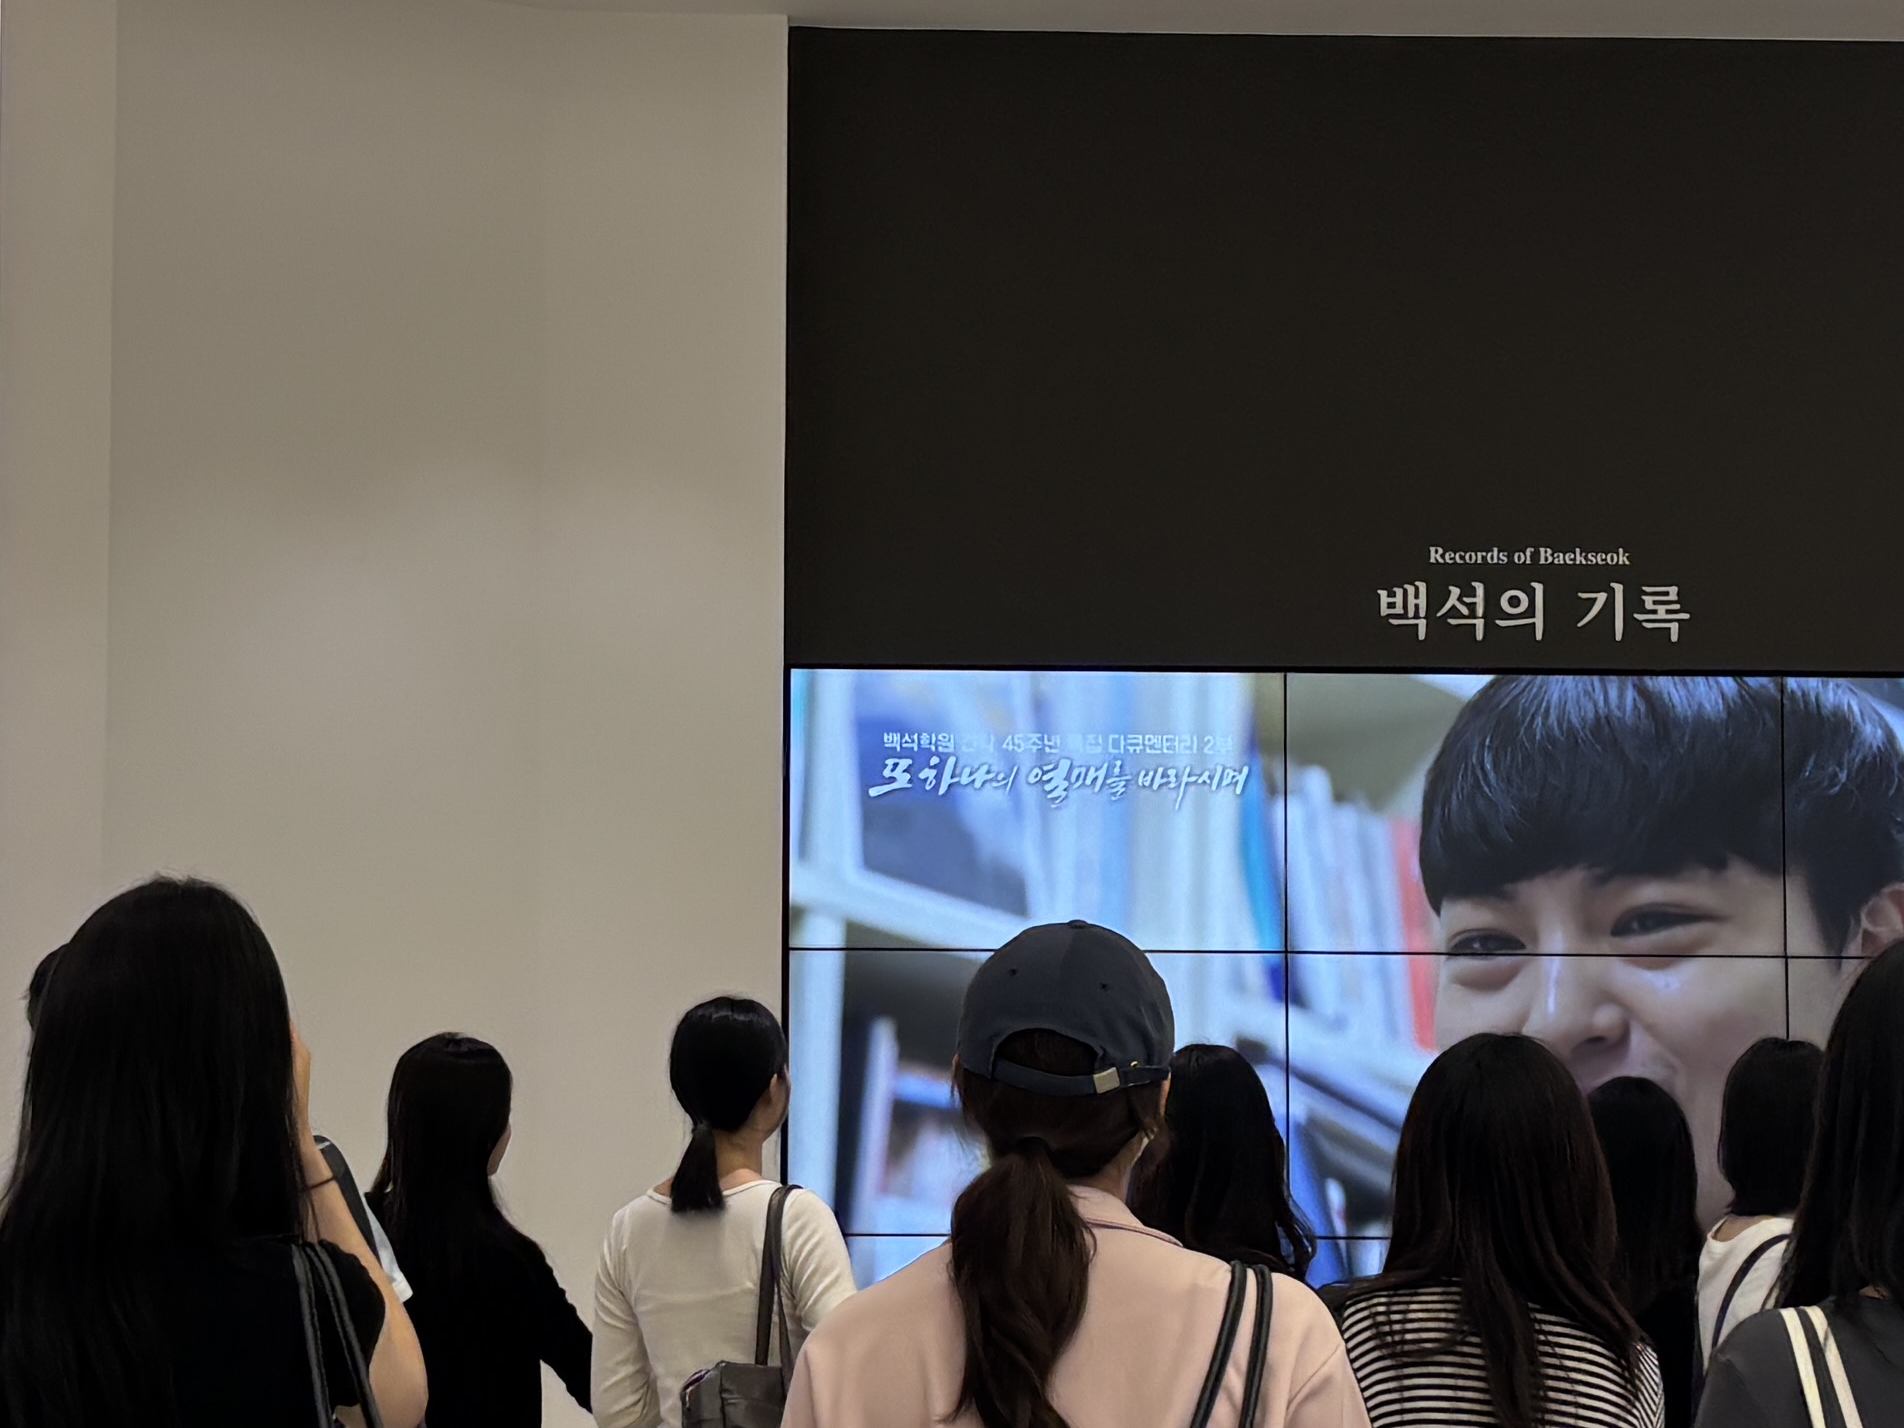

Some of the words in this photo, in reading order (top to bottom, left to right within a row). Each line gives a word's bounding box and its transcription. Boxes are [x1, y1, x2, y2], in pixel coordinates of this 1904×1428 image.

[1429, 546, 1508, 565] Records
[1513, 547, 1535, 565] of
[1539, 548, 1631, 566] Baekseok
[1377, 581, 1544, 642] 백석의
[1577, 582, 1691, 643] 기록
[883, 732, 955, 753] 백석학원
[1002, 733, 1061, 753] 45주년
[867, 758, 913, 798] 또
[918, 755, 1018, 796] 하나의
